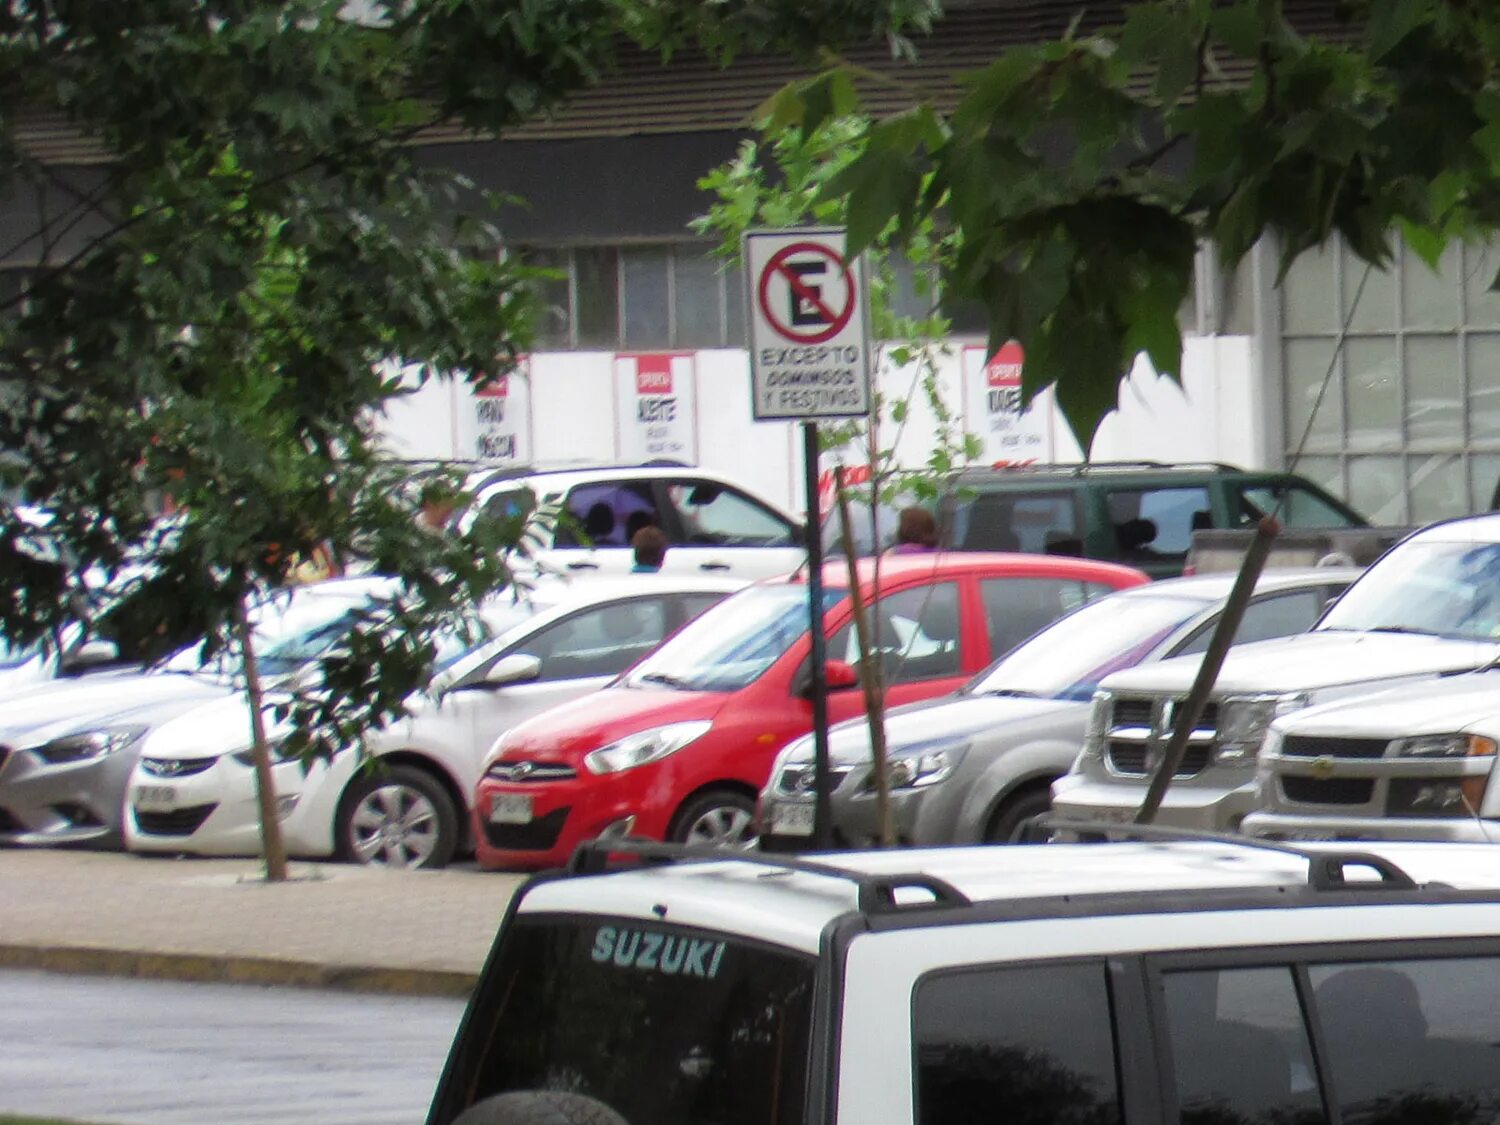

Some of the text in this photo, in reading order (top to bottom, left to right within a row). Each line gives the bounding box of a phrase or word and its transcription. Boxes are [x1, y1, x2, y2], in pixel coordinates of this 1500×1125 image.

[761, 345, 859, 366] EXCEPTO
[780, 388, 859, 408] FESTIVOS
[591, 926, 726, 979] SUZUKI
